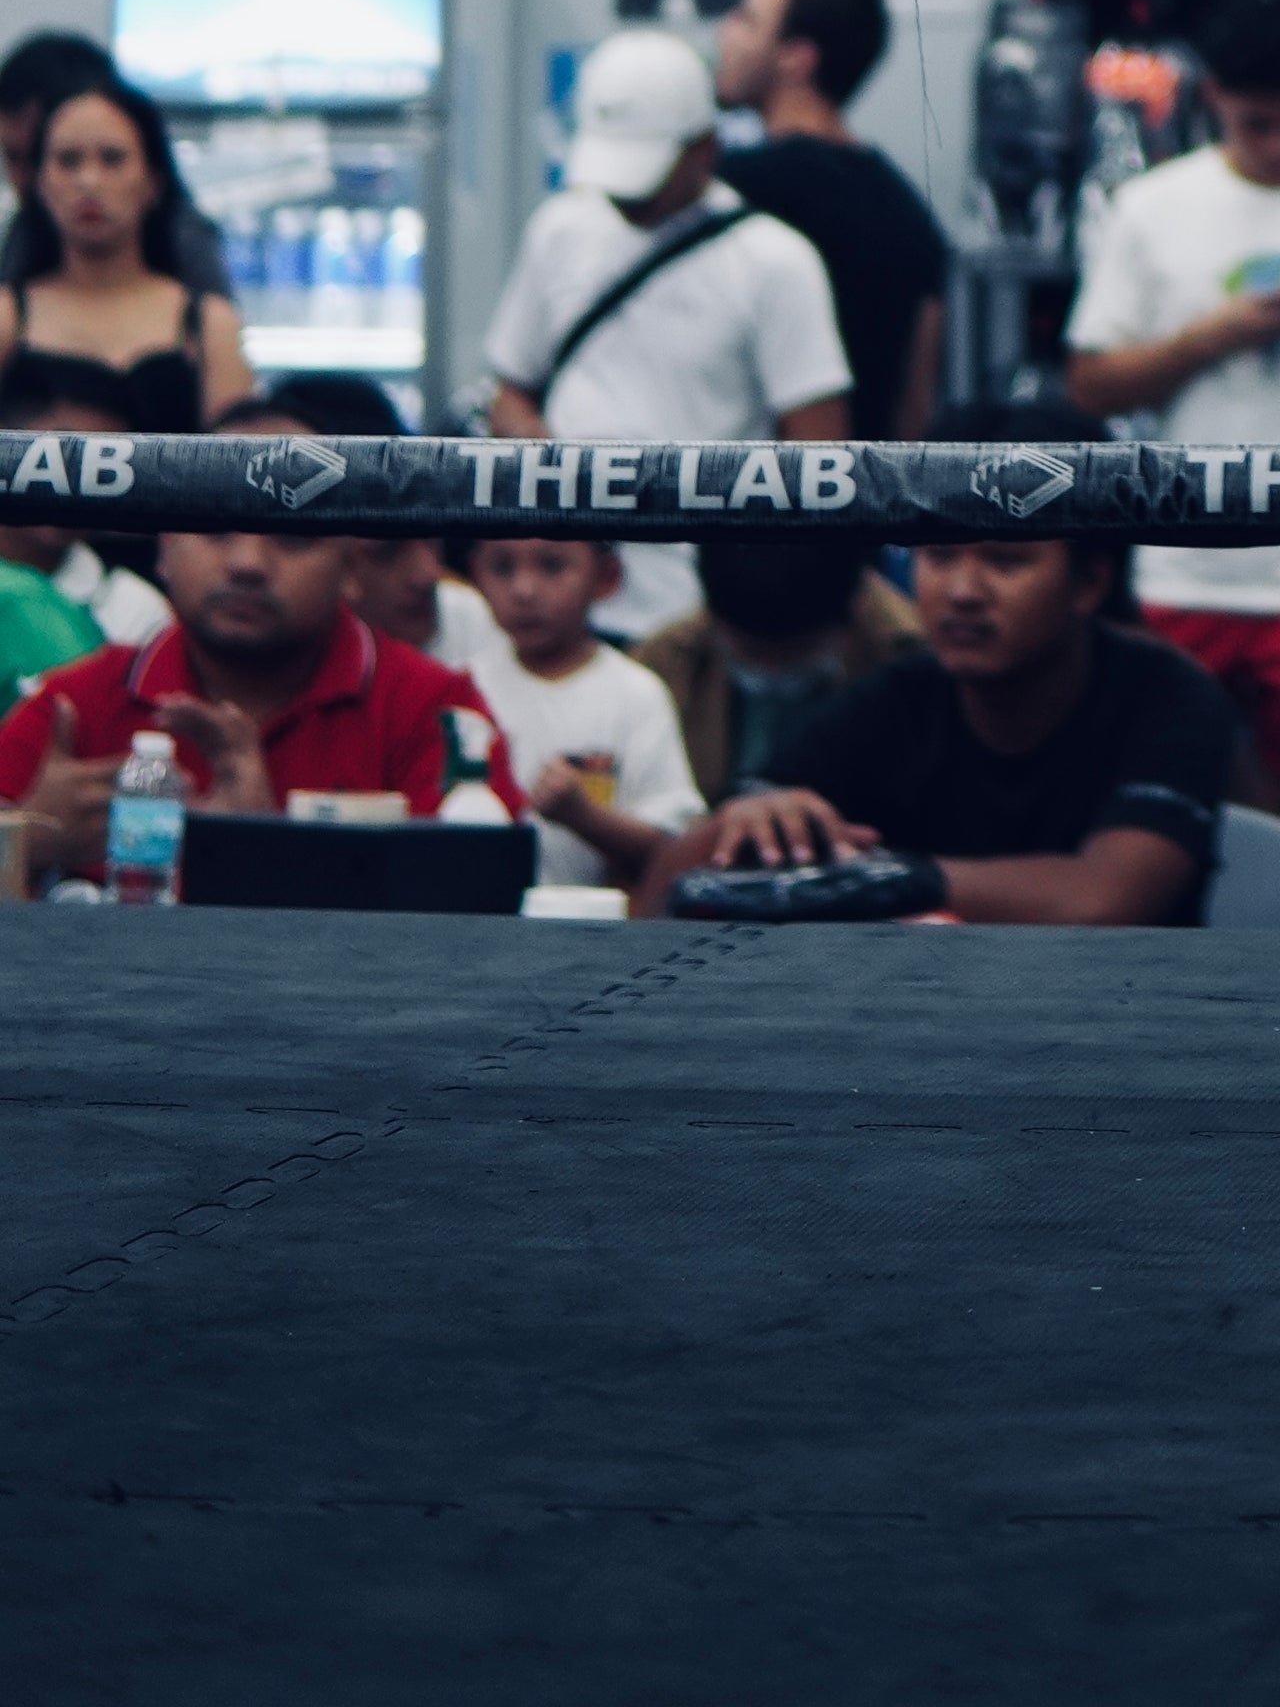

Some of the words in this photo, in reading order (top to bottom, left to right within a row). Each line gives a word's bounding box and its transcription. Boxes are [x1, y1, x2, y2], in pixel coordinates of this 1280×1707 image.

[0, 438, 135, 498] AB
[458, 445, 640, 509] THE
[677, 447, 856, 510] LAB
